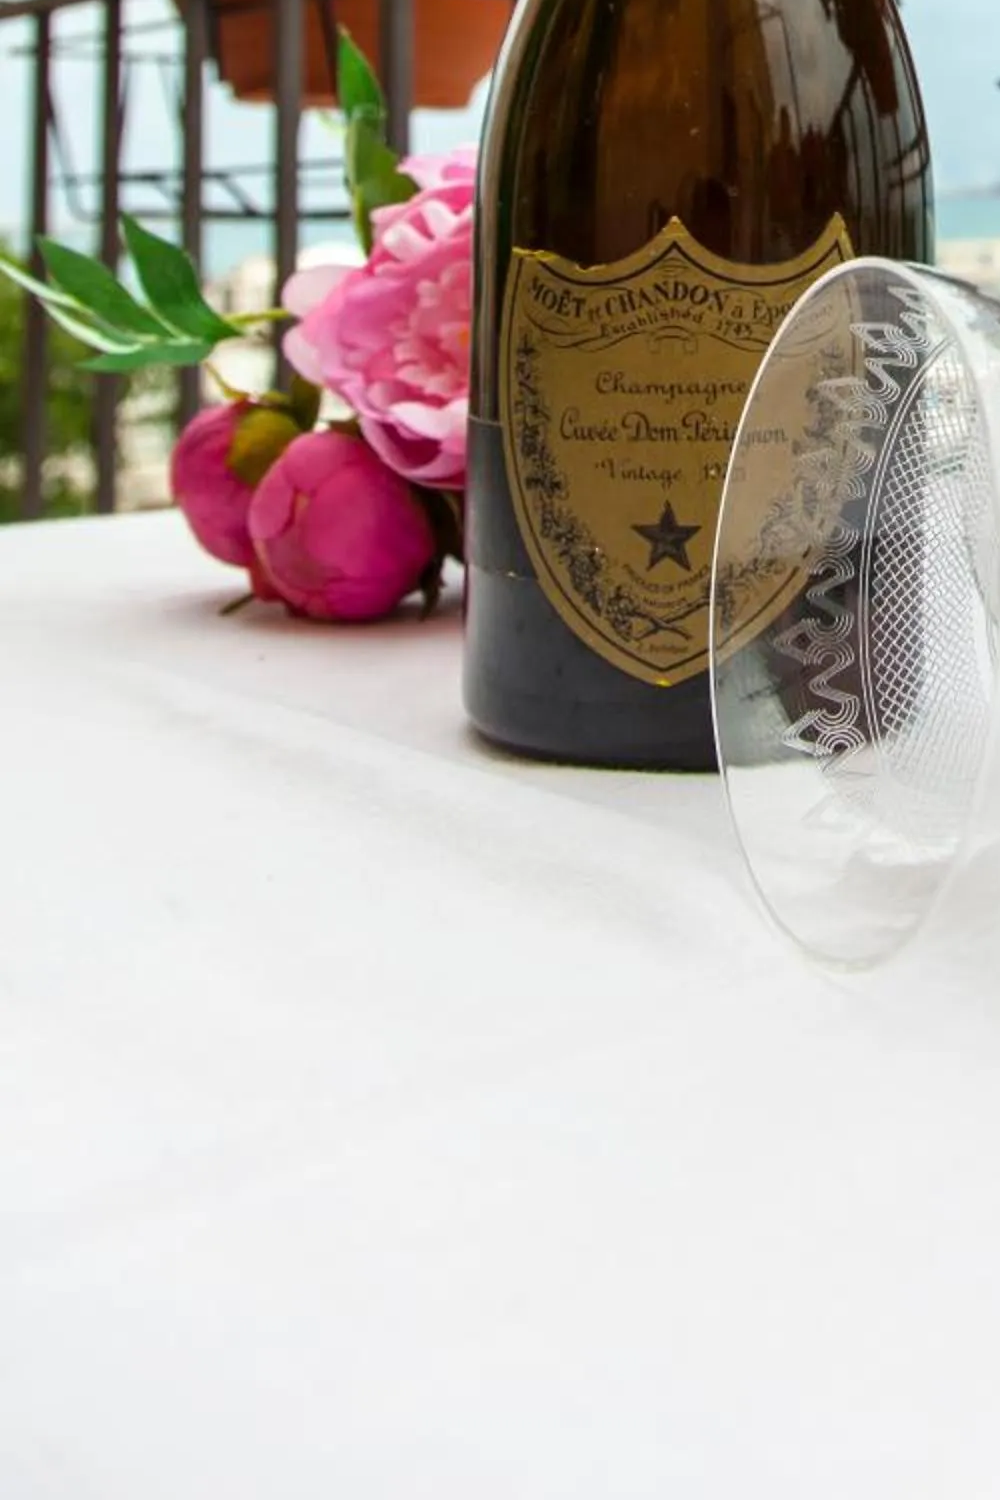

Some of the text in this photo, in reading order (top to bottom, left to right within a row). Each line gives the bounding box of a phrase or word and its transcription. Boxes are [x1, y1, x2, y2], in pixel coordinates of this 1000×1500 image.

[604, 280, 729, 315] CHANDON
[600, 308, 704, 337] Established
[595, 371, 748, 405] Champagne
[559, 406, 619, 442] Cuvée
[621, 411, 678, 442] Dom
